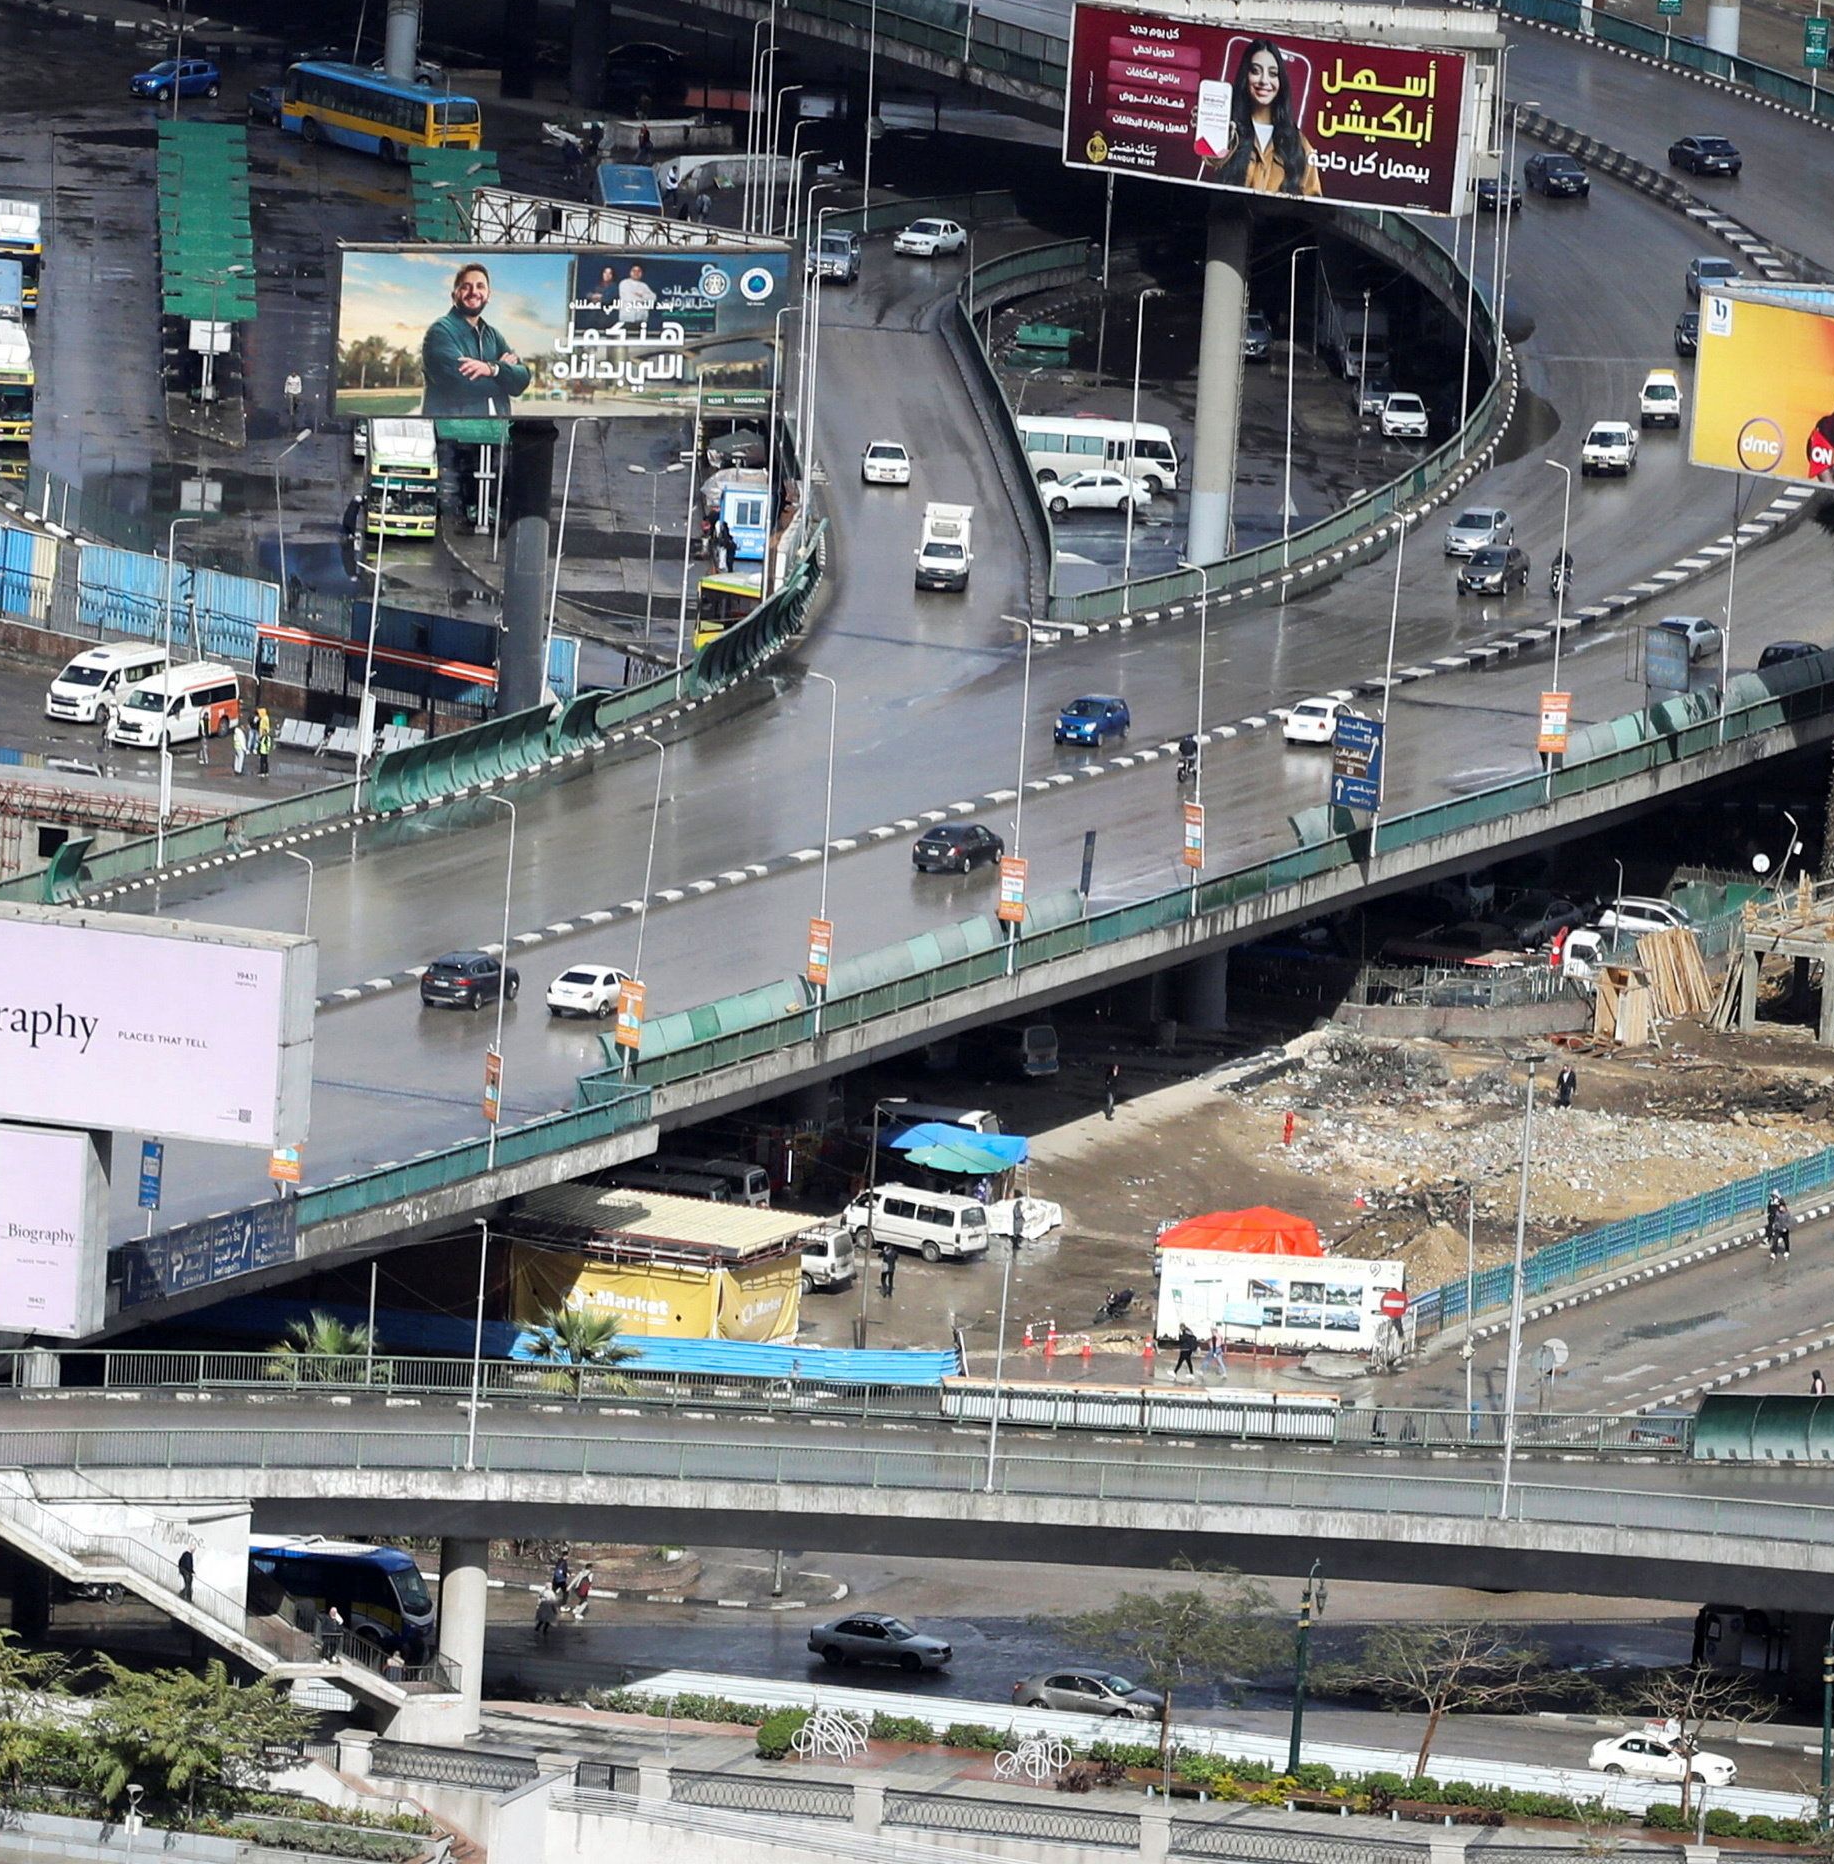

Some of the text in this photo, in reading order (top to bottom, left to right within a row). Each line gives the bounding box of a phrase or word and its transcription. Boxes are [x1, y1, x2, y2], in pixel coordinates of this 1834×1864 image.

[1321, 59, 1437, 100] أسهل
[1316, 99, 1435, 149] أبلكيشن
[1307, 148, 1431, 185] بيعمل كل حاجة
[555, 320, 685, 354] هنكمل
[625, 354, 683, 393] اللي
[1741, 434, 1780, 456] dmc
[1811, 446, 1833, 466] ON
[236, 971, 258, 982] 19431
[118, 1030, 208, 1049] PLACES THAT TELL
